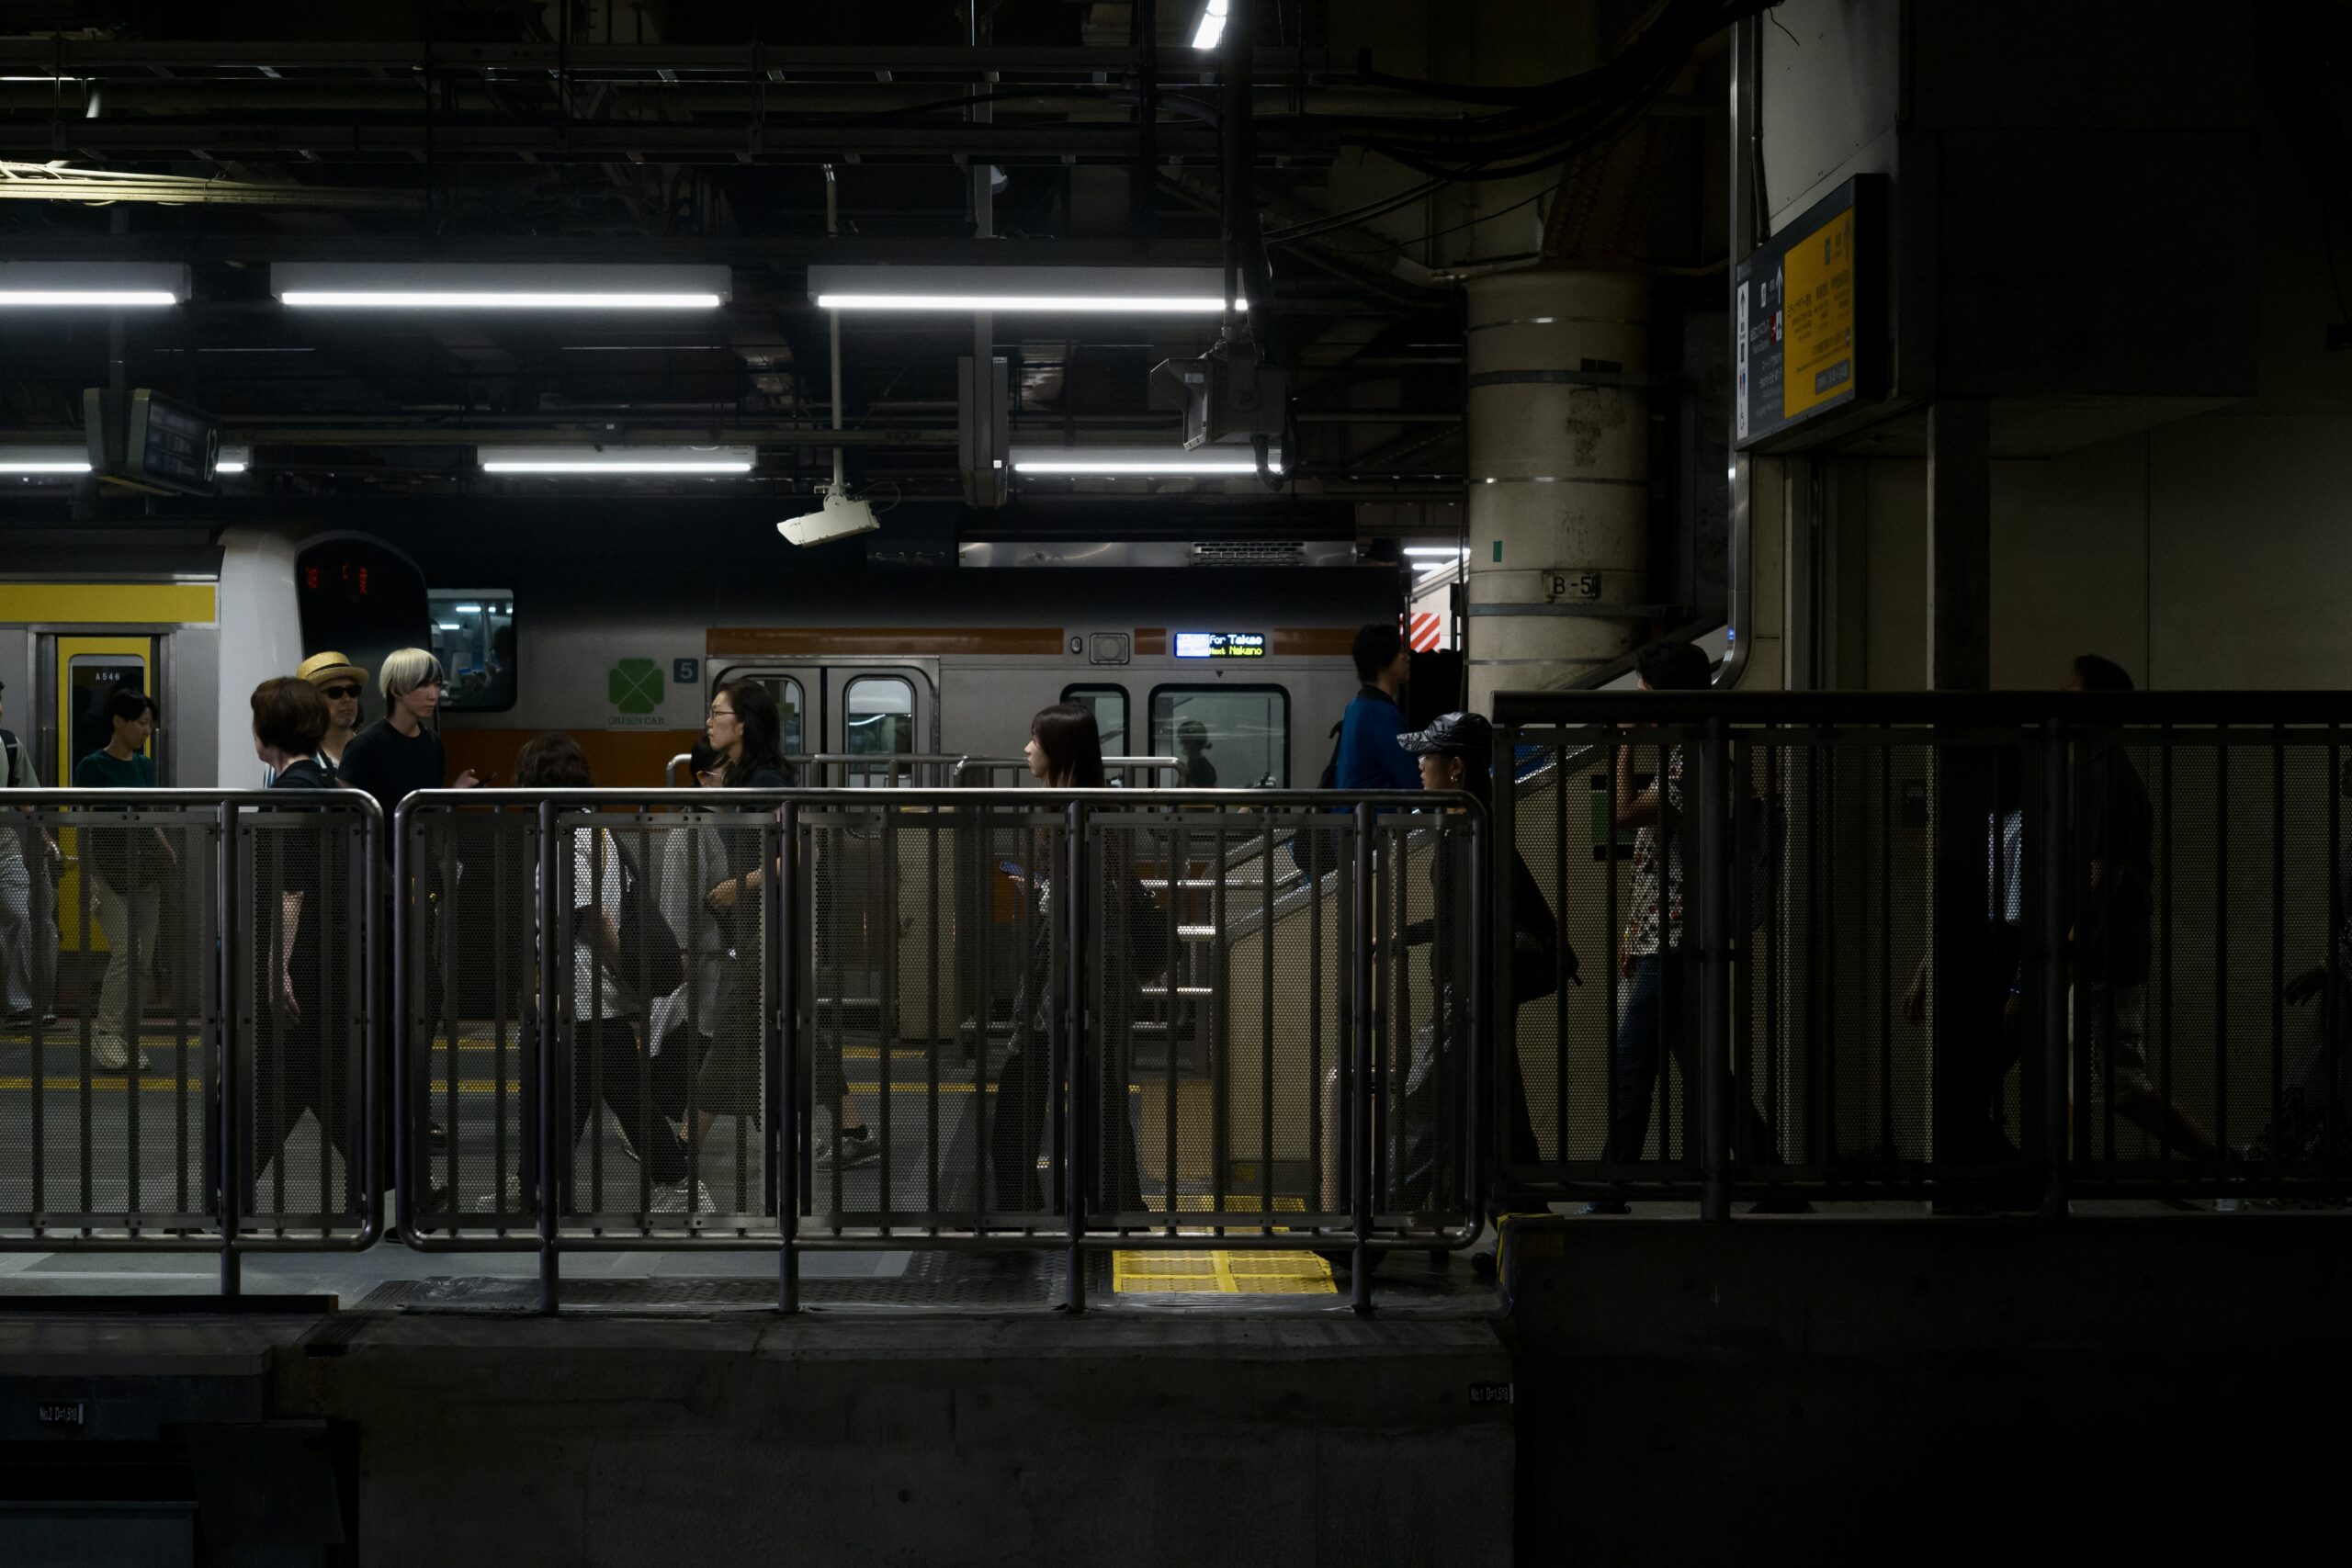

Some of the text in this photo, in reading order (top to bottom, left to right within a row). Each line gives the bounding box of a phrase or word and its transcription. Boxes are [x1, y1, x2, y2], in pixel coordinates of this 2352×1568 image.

[1227, 634, 1263, 645] Takao
[1228, 646, 1263, 656] Nakano
[679, 661, 694, 680] 5
[608, 716, 665, 726] GREEN CAR
